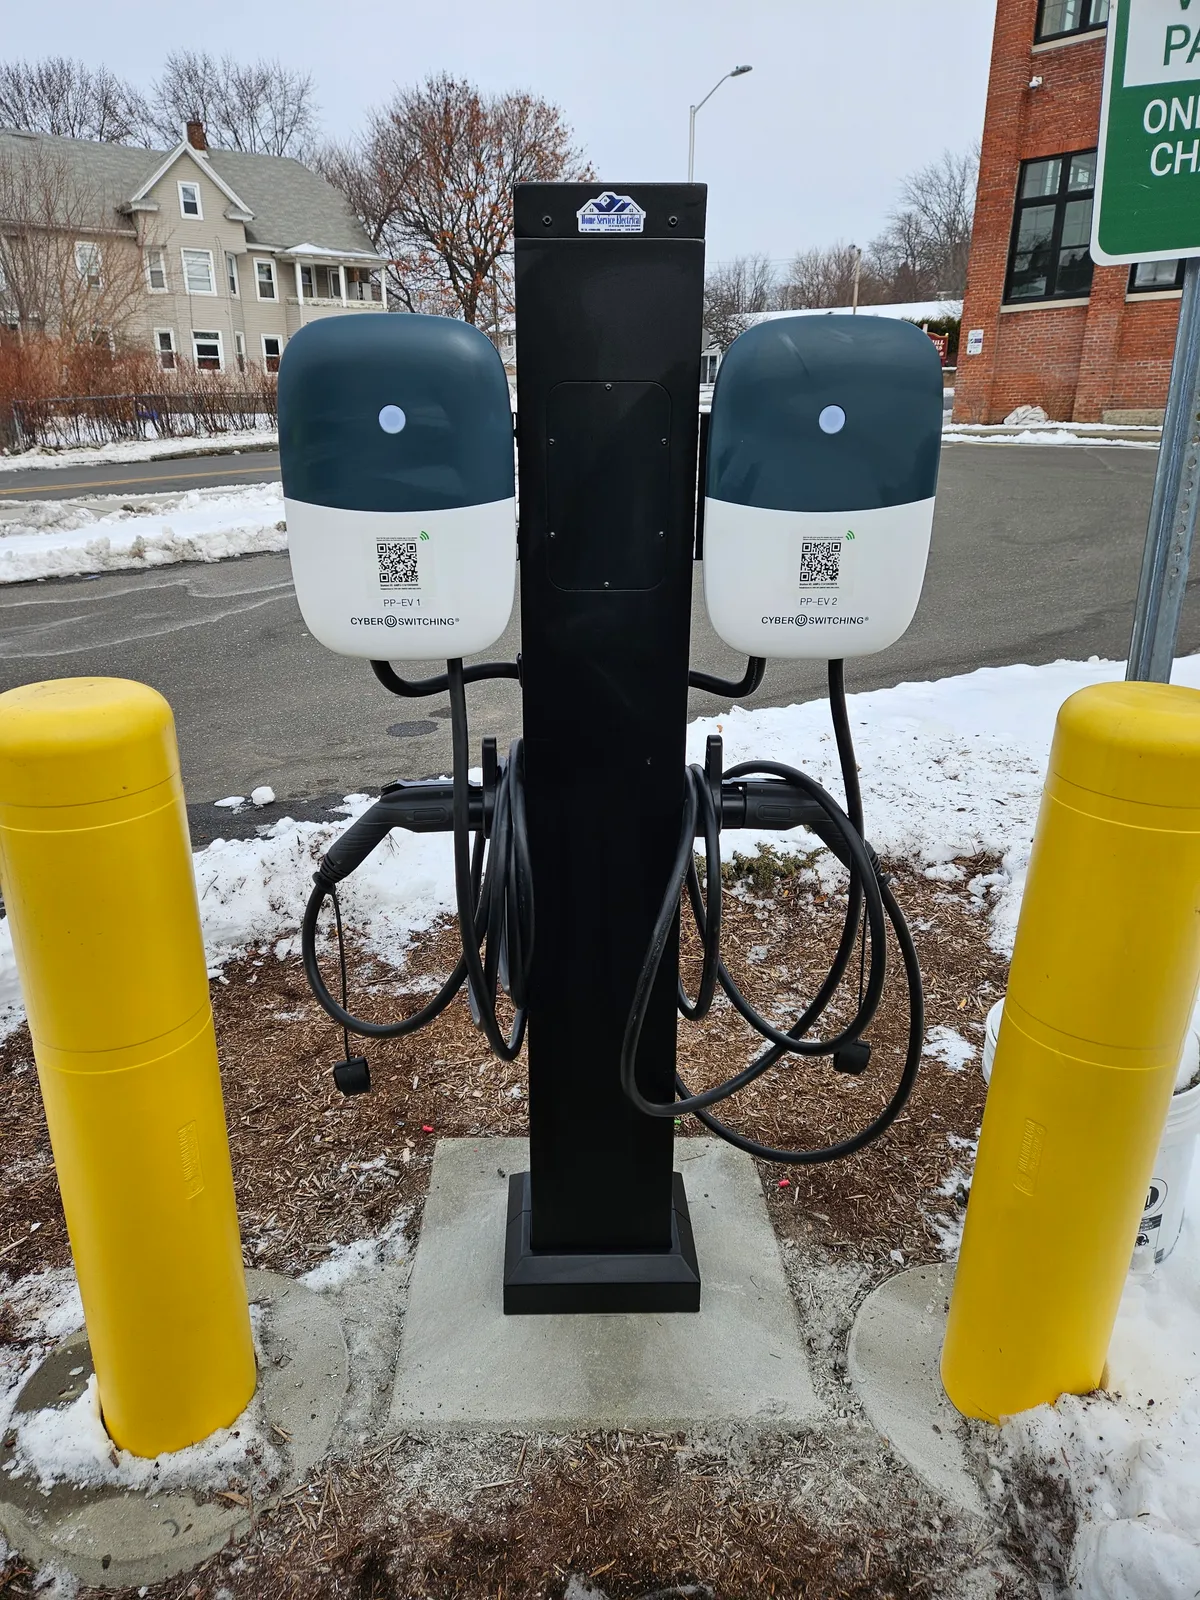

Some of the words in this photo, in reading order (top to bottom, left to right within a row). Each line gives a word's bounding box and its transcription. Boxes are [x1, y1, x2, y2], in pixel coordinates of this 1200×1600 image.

[1143, 95, 1200, 134] ON
[1150, 139, 1200, 177] CH
[581, 214, 596, 224] Home
[597, 214, 616, 225] Service
[616, 214, 642, 225] Electrical
[383, 599, 414, 607] PP-EV
[416, 599, 421, 607] 1
[799, 597, 830, 606] PP-EV
[831, 597, 838, 606] 2
[350, 617, 384, 626] CYBER
[761, 616, 795, 625] CYBER
